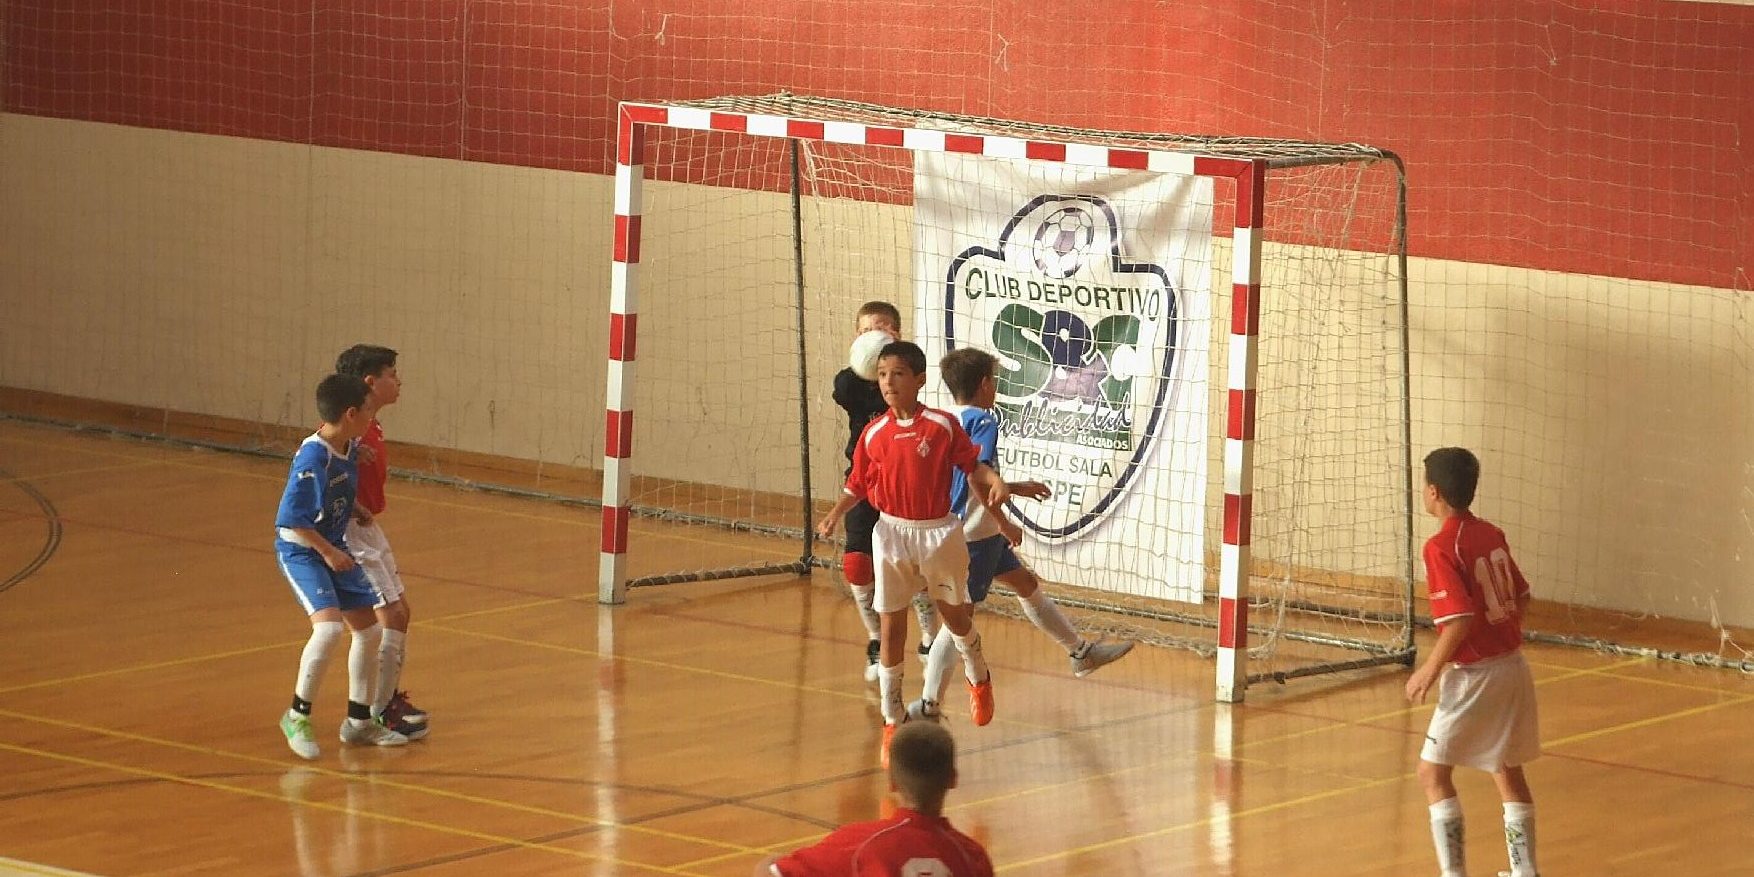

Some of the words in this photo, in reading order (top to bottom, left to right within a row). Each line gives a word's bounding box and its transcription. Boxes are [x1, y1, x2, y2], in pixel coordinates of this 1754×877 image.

[965, 267, 1022, 300] CLUB
[1027, 280, 1160, 322] DEPORTIVO
[1076, 434, 1129, 450] ASOCIADOS
[1068, 455, 1113, 478] SALA
[1473, 546, 1517, 625] 10
